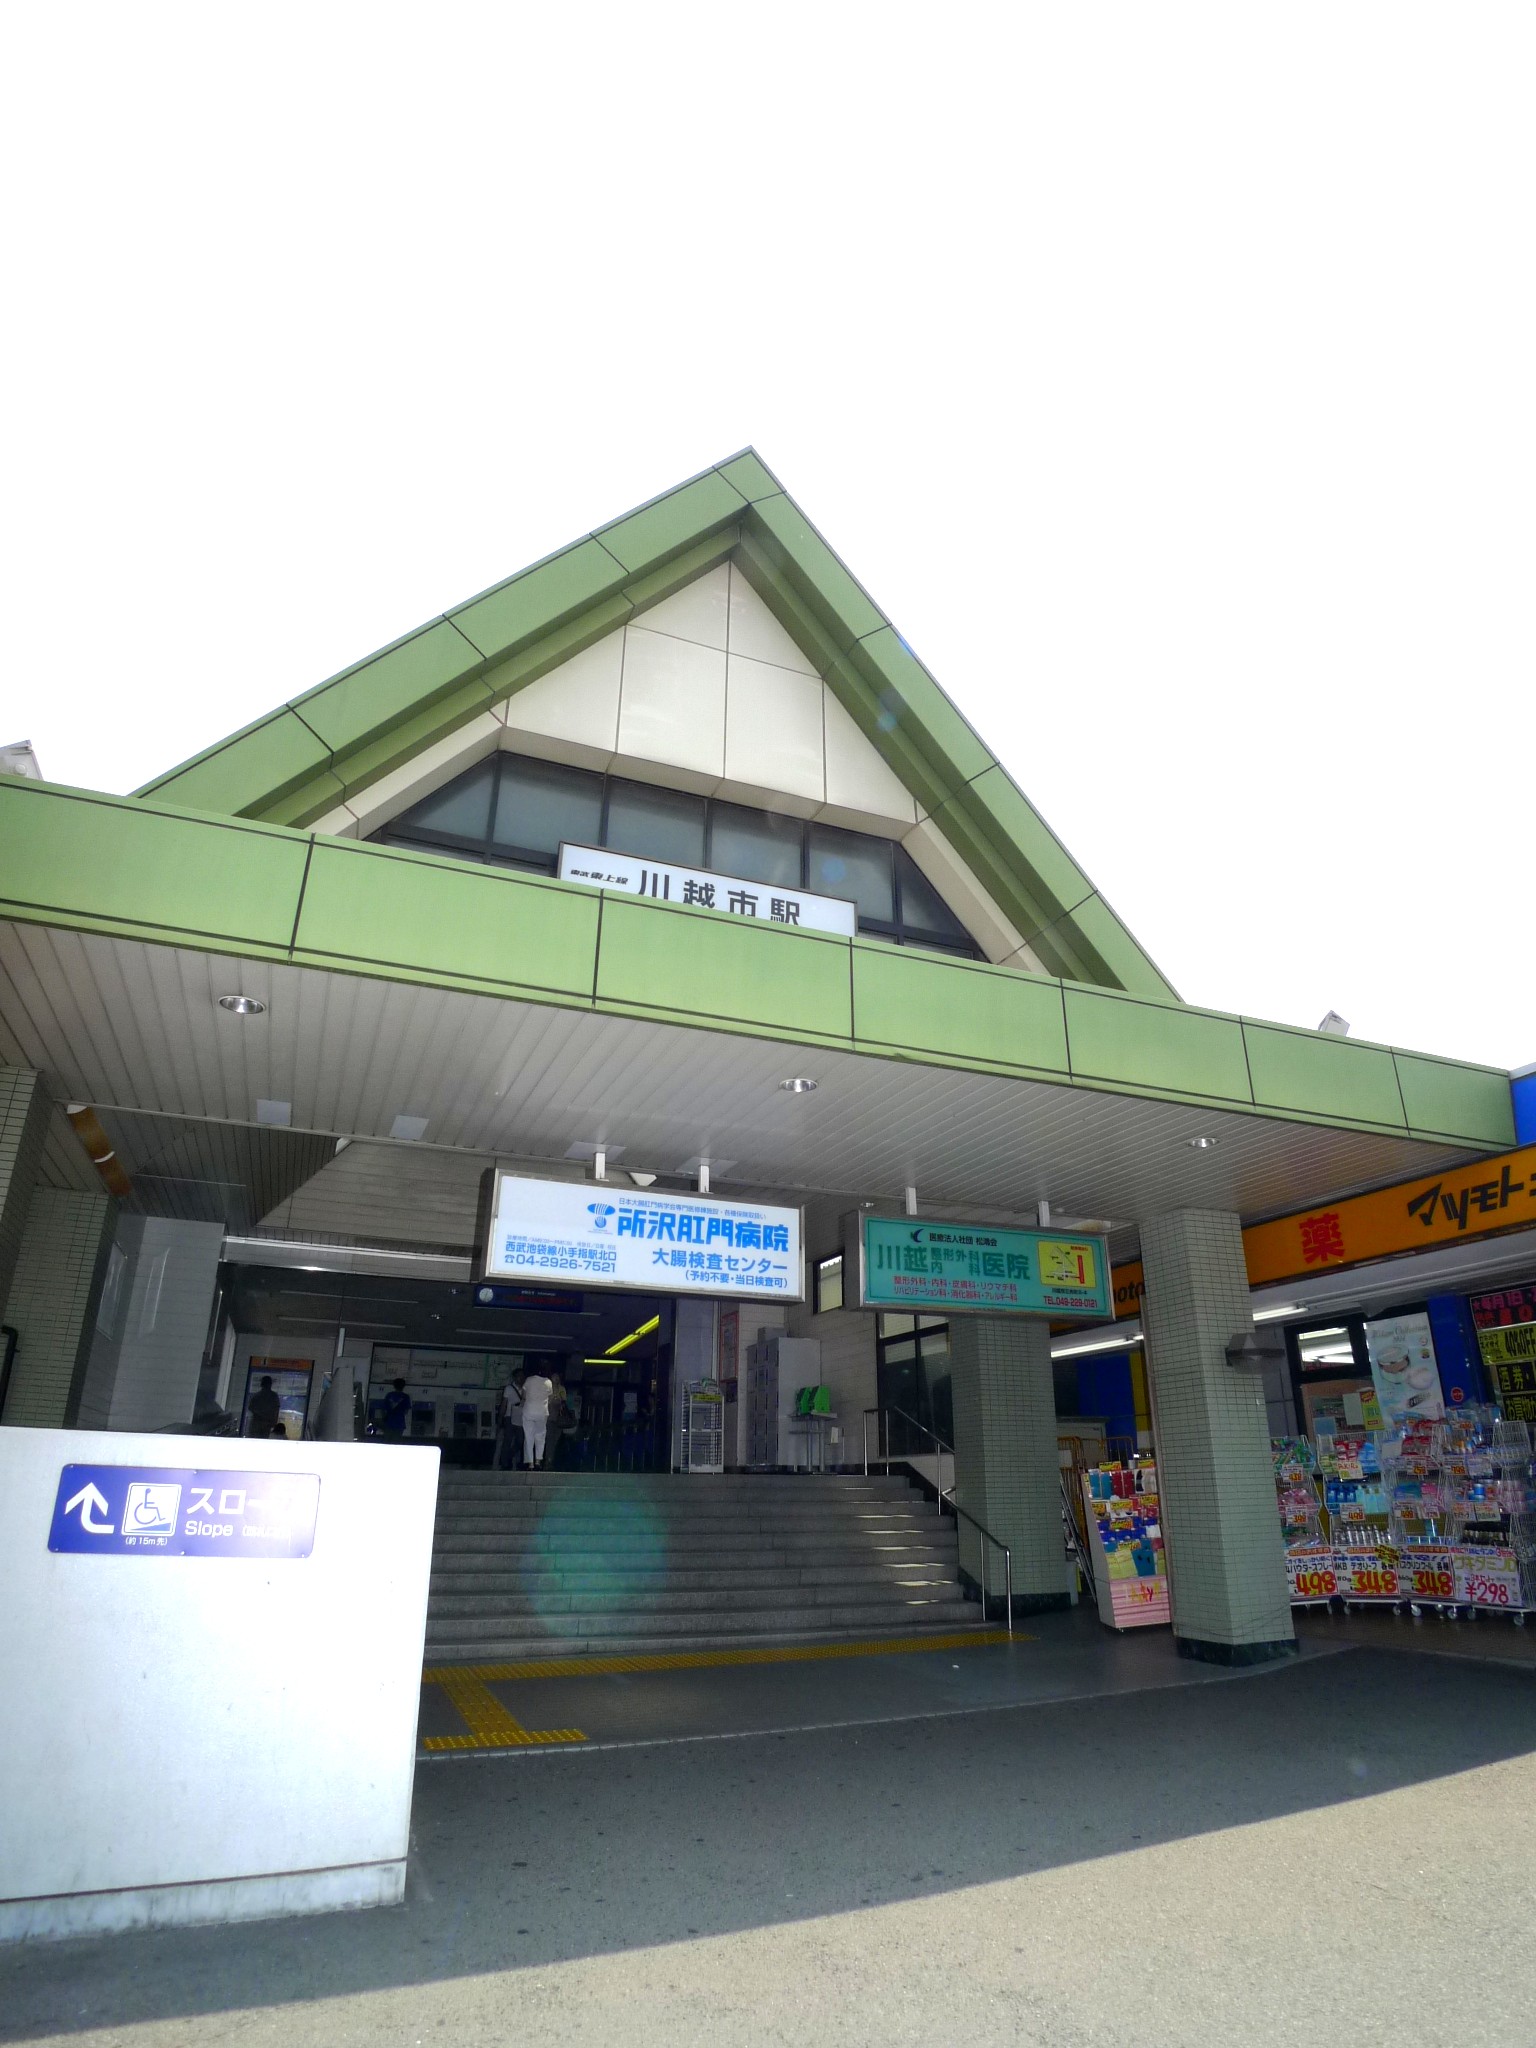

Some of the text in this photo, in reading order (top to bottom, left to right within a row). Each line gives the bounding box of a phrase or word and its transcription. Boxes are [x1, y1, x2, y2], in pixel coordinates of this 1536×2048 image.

[638, 868, 801, 926] 川越市駅
[1407, 1164, 1536, 1230] マツモト
[616, 1207, 790, 1252] 所沢肛門病院
[1299, 1212, 1346, 1264] 薬
[505, 1240, 617, 1262] 西武池袋線小手指駅北口
[515, 1253, 616, 1273] 04-2926-7521
[651, 1247, 788, 1275] 大腸検査センター
[877, 1243, 929, 1273] 川越
[982, 1252, 1030, 1280] 医院
[187, 1487, 291, 1515] スロー
[184, 1520, 234, 1538] Slope
[1296, 1570, 1336, 1596] 498
[1351, 1570, 1397, 1594] 348
[1412, 1570, 1453, 1597] 348
[1465, 1581, 1510, 1605] ¥298
